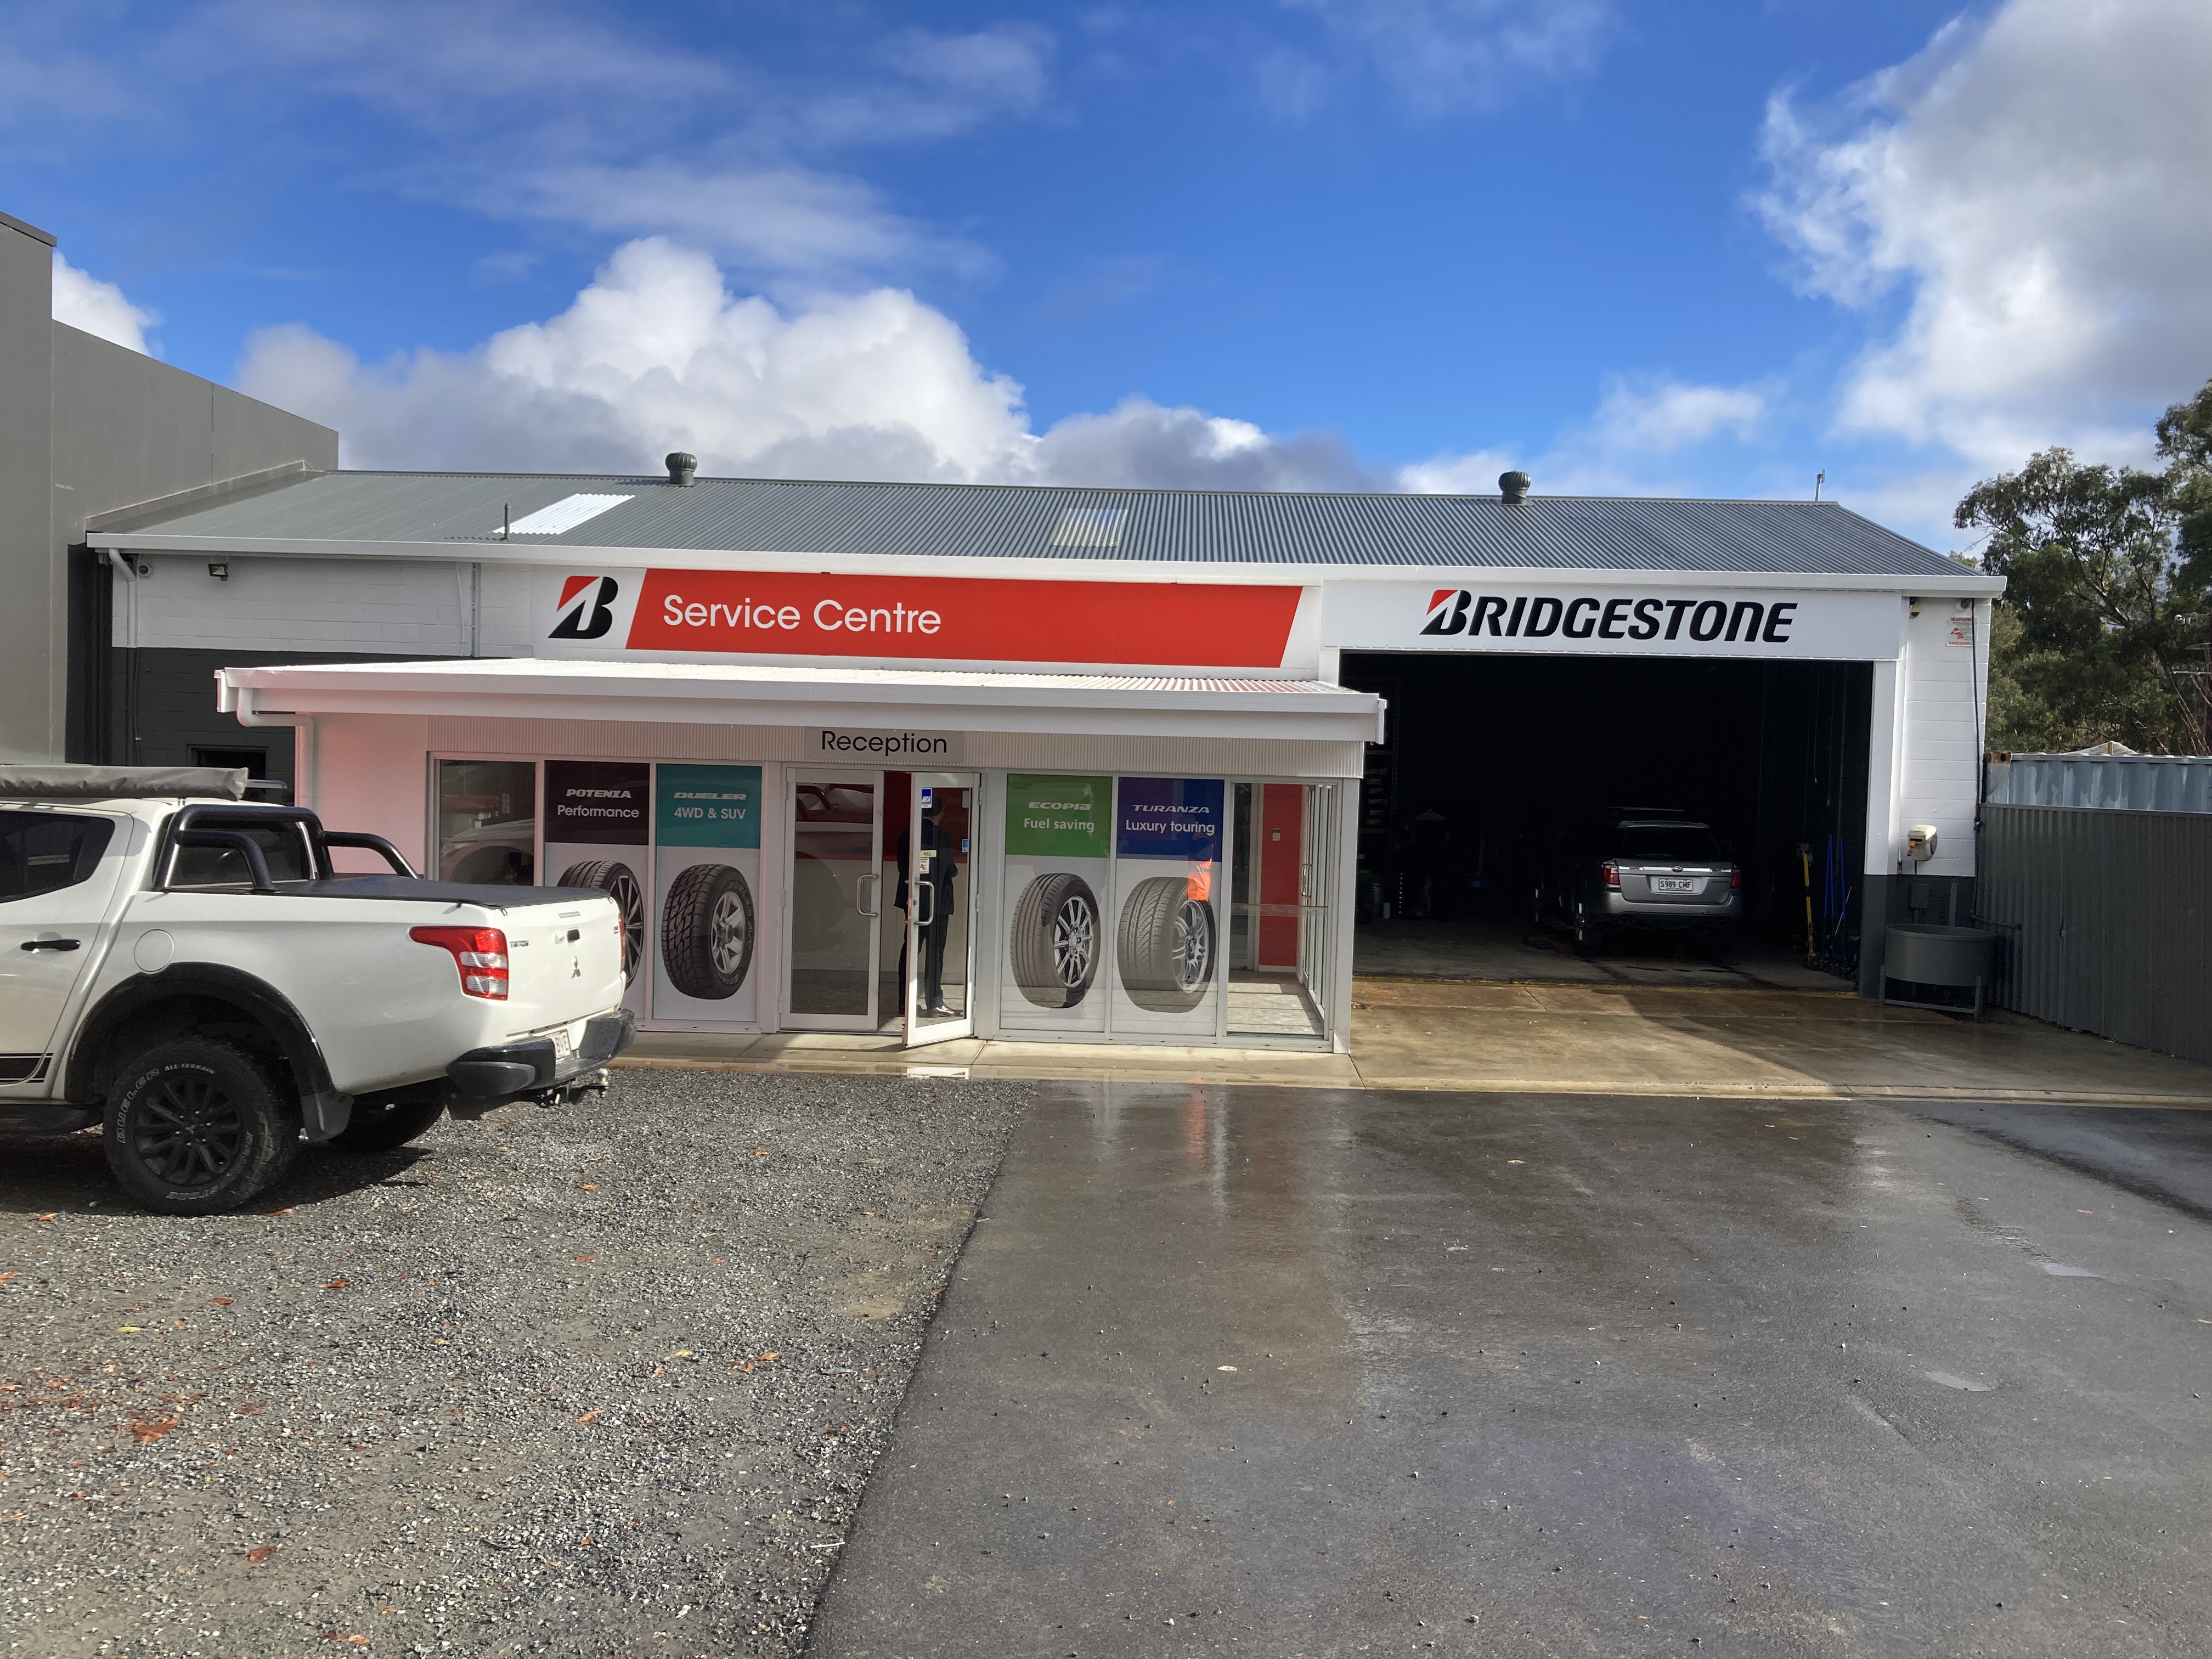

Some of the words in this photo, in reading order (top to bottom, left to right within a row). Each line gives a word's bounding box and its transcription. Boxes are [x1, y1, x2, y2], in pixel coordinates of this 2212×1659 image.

[663, 594, 800, 630] Service
[813, 599, 941, 634] Centre
[1419, 589, 1798, 642] BRIDGESTONE
[821, 730, 947, 757] Reception
[566, 788, 632, 799] POTENZA
[674, 792, 747, 800] DUELER
[557, 805, 640, 818] Performance
[674, 807, 704, 819] 4WD
[707, 808, 716, 819] &
[721, 808, 746, 820] SUV
[1132, 804, 1210, 814] TURANZA
[1024, 818, 1049, 829] Fuel
[1053, 820, 1094, 833] saving
[1126, 820, 1167, 834] Luxury
[1170, 821, 1215, 836] touring
[165, 1063, 215, 1074] ALL-TERRAIN
[116, 1068, 160, 1144] DUELER
